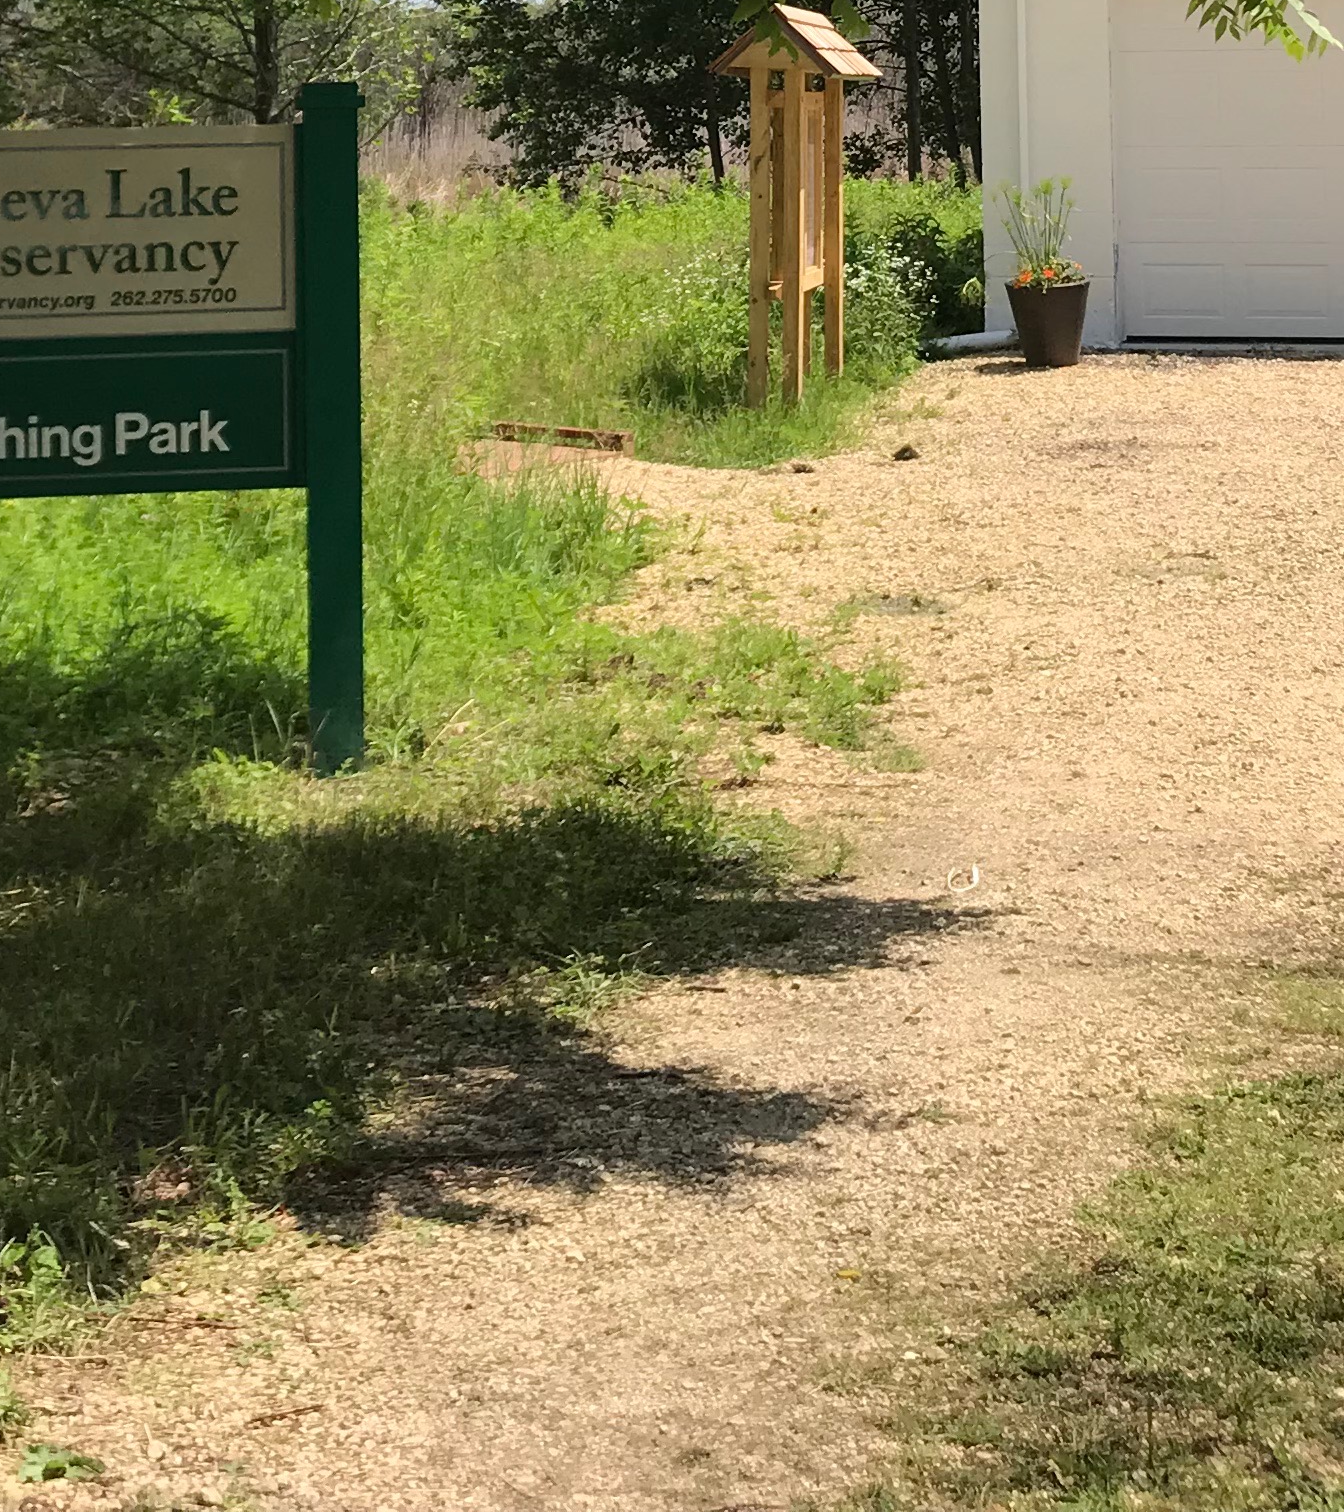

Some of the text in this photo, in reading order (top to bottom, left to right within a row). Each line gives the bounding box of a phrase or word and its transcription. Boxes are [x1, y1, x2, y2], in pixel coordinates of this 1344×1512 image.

[104, 166, 239, 219] Lake
[110, 287, 237, 307] 262.275.5700
[115, 409, 231, 456] Park
